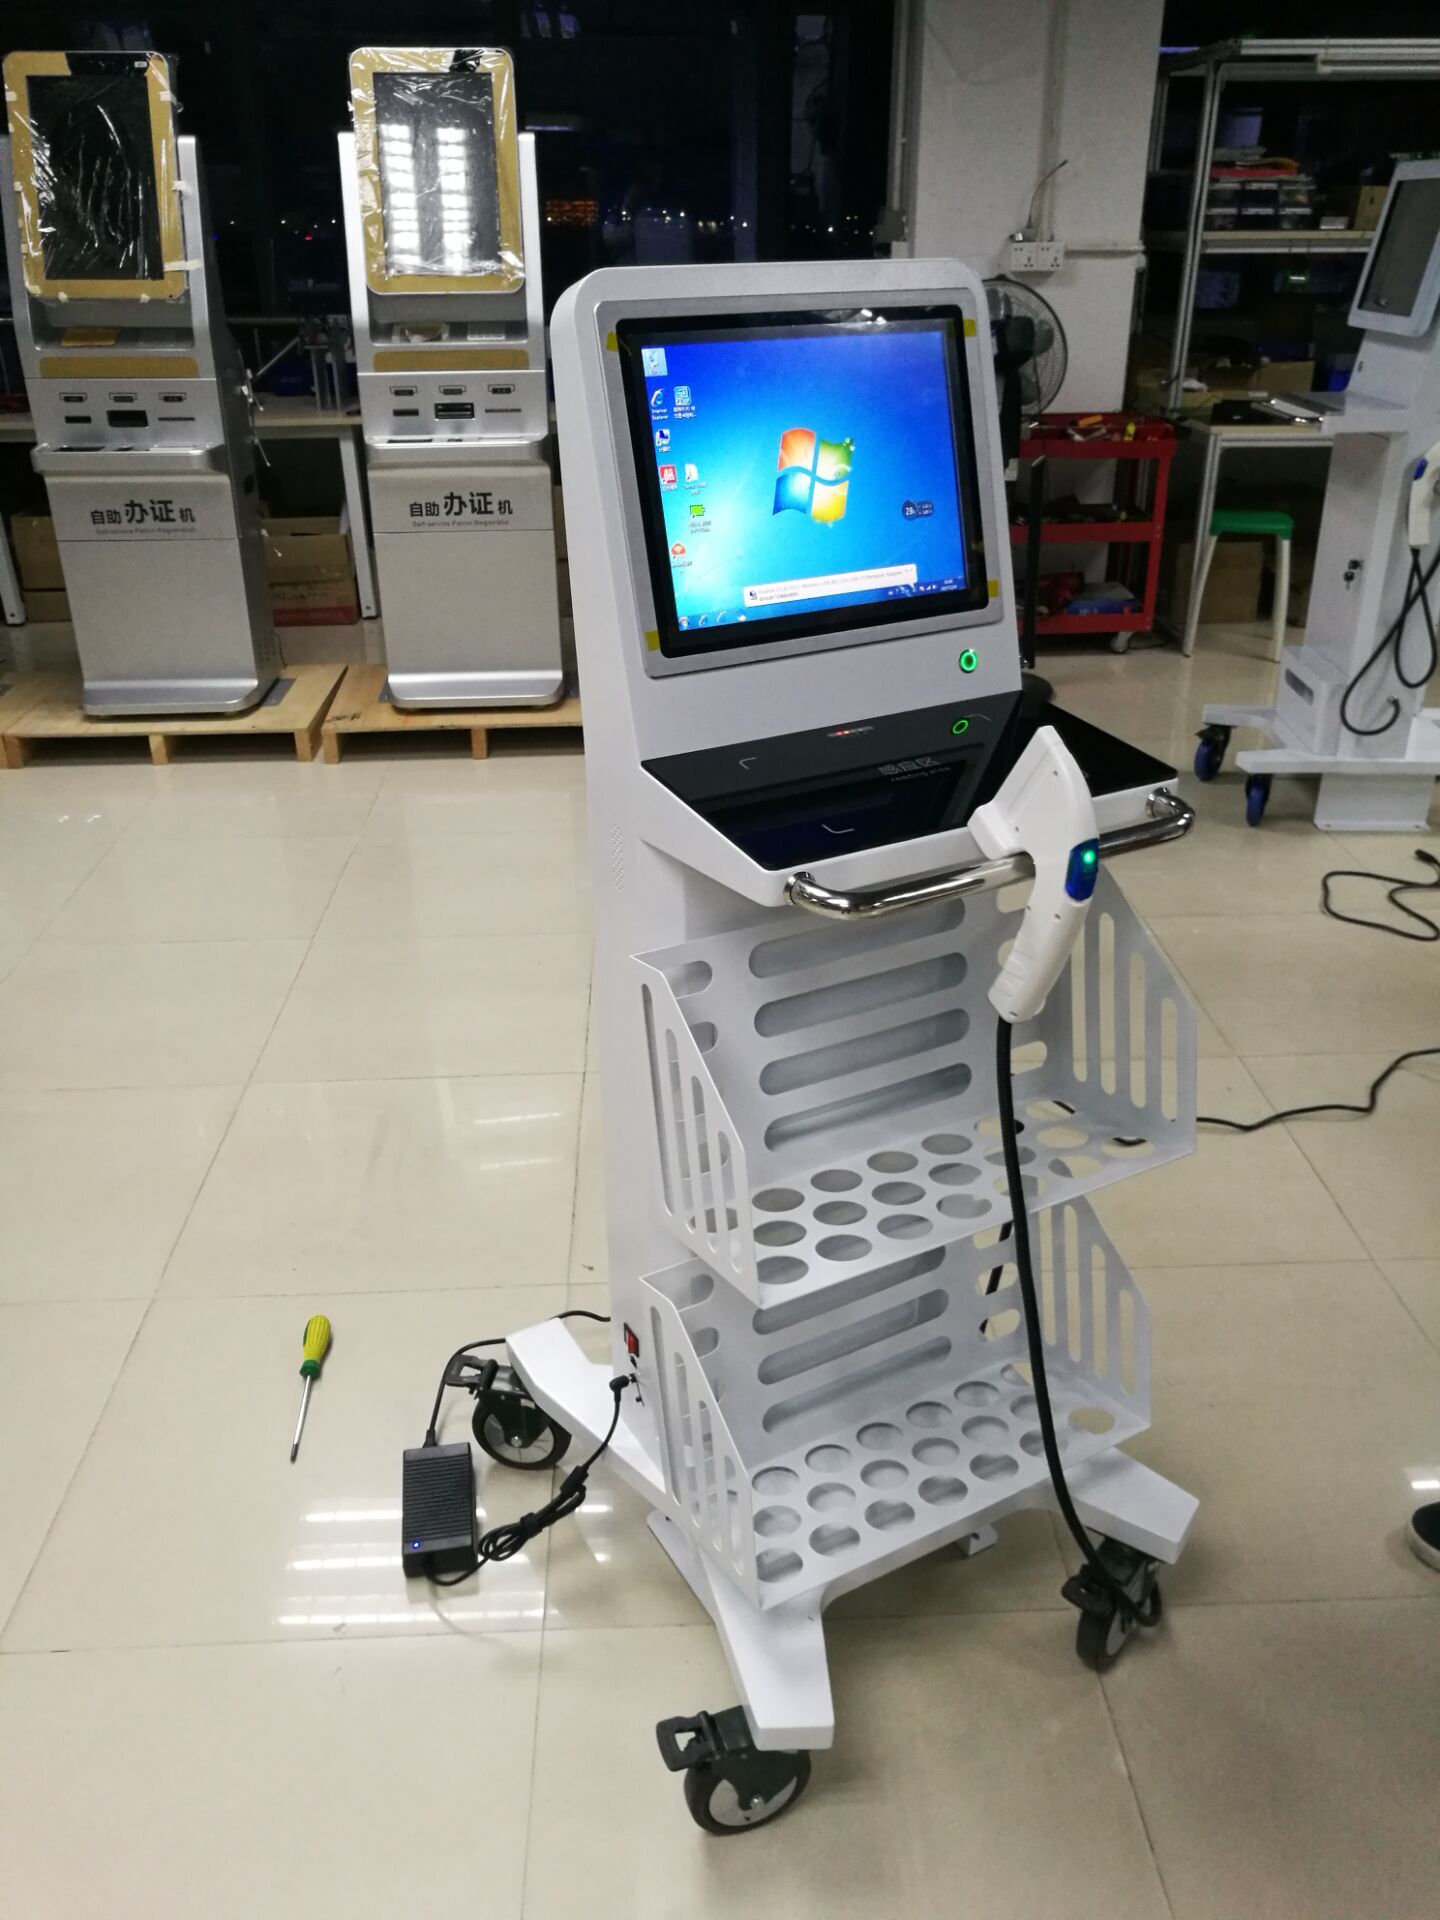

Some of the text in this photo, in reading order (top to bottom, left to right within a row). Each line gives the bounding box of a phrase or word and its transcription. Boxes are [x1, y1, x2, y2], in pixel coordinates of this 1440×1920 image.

[91, 499, 196, 525] 自助办证机
[409, 491, 513, 518] 自助办证机
